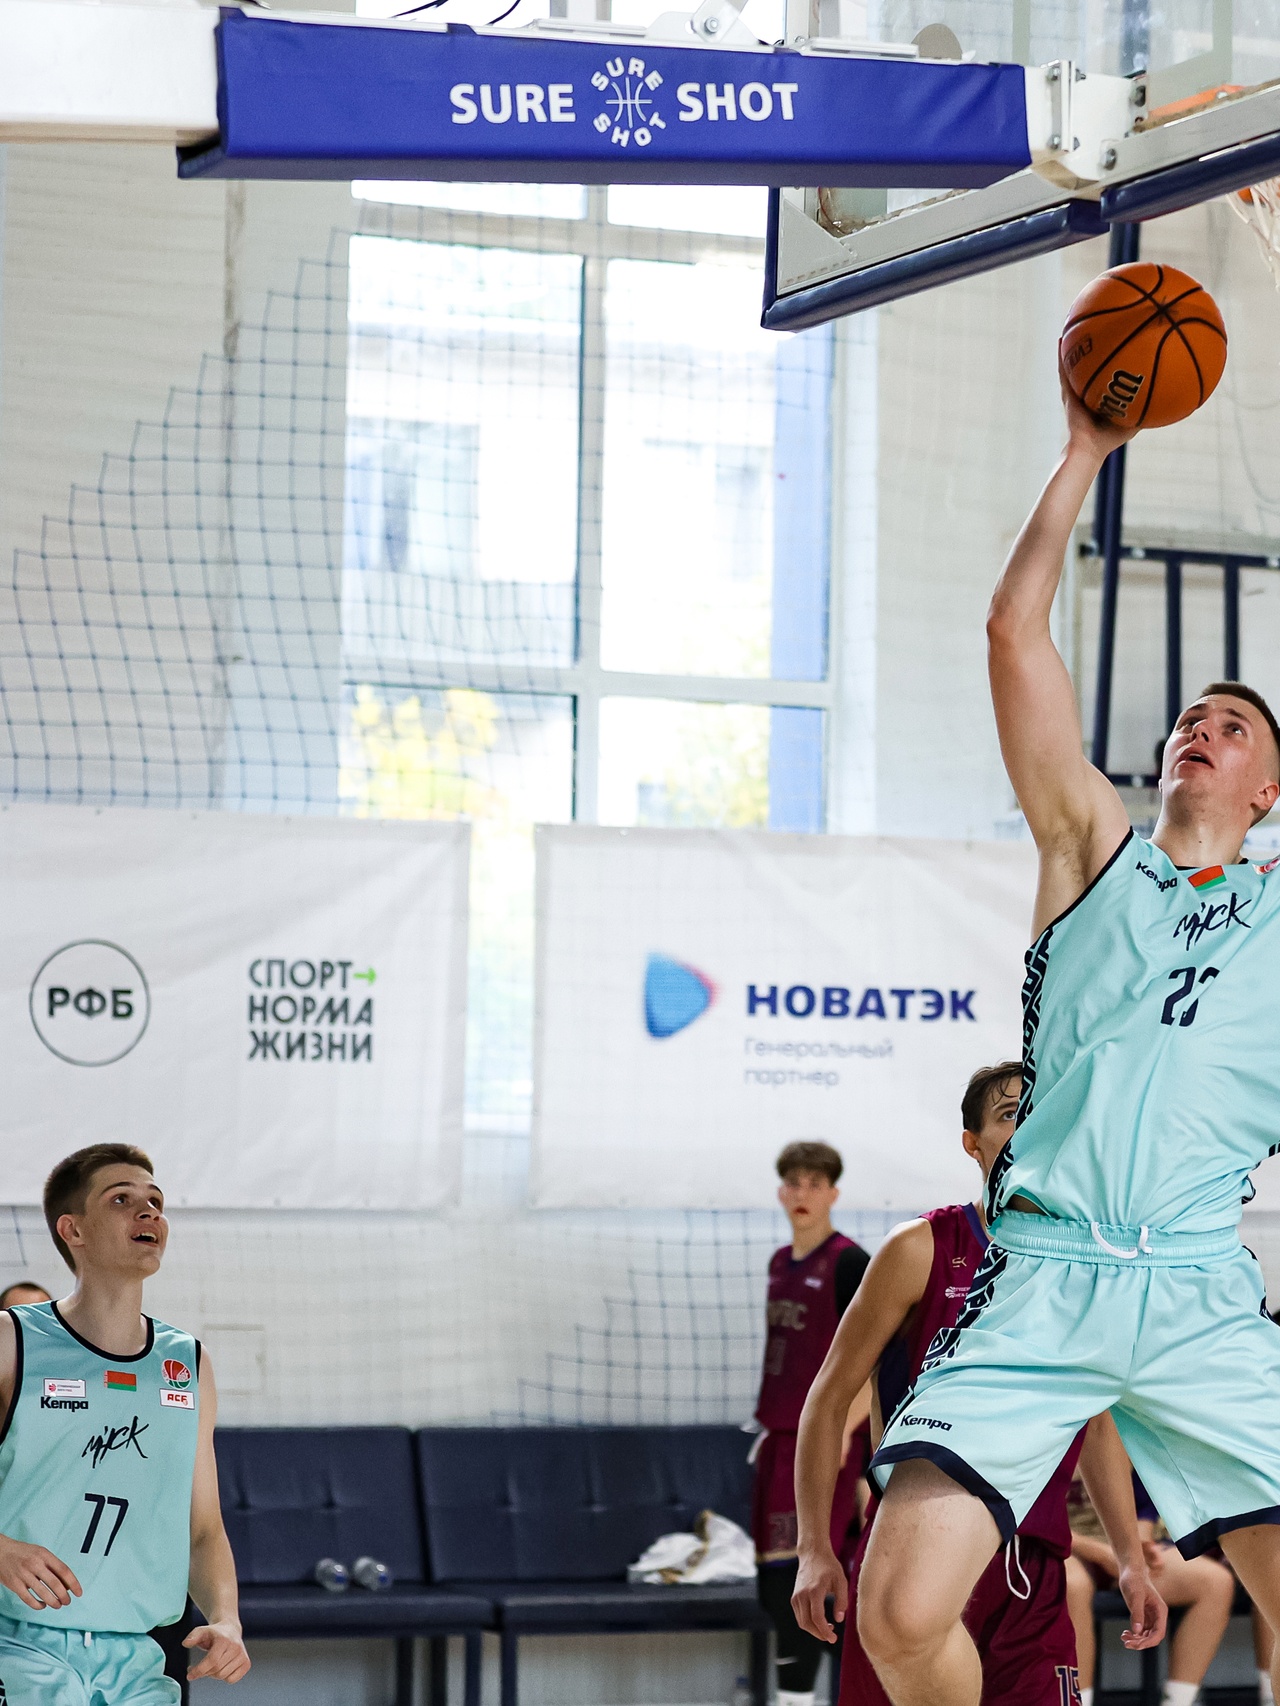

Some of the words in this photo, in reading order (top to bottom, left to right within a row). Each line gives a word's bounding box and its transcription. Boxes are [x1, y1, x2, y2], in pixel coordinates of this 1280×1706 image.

[591, 56, 664, 92] SURE
[449, 83, 577, 125] SURE
[676, 81, 799, 122] SHOT
[592, 111, 668, 148] SHOT
[248, 959, 353, 989] СПОРТ
[46, 987, 135, 1019] РФБ
[248, 995, 375, 1027] НОРМА
[745, 984, 977, 1022] НОВАТЭК
[248, 1030, 374, 1062] ЖИЗНИ
[40, 1396, 89, 1413] Kempa
[899, 1414, 953, 1432] Kempa
[79, 1492, 130, 1557] 77
